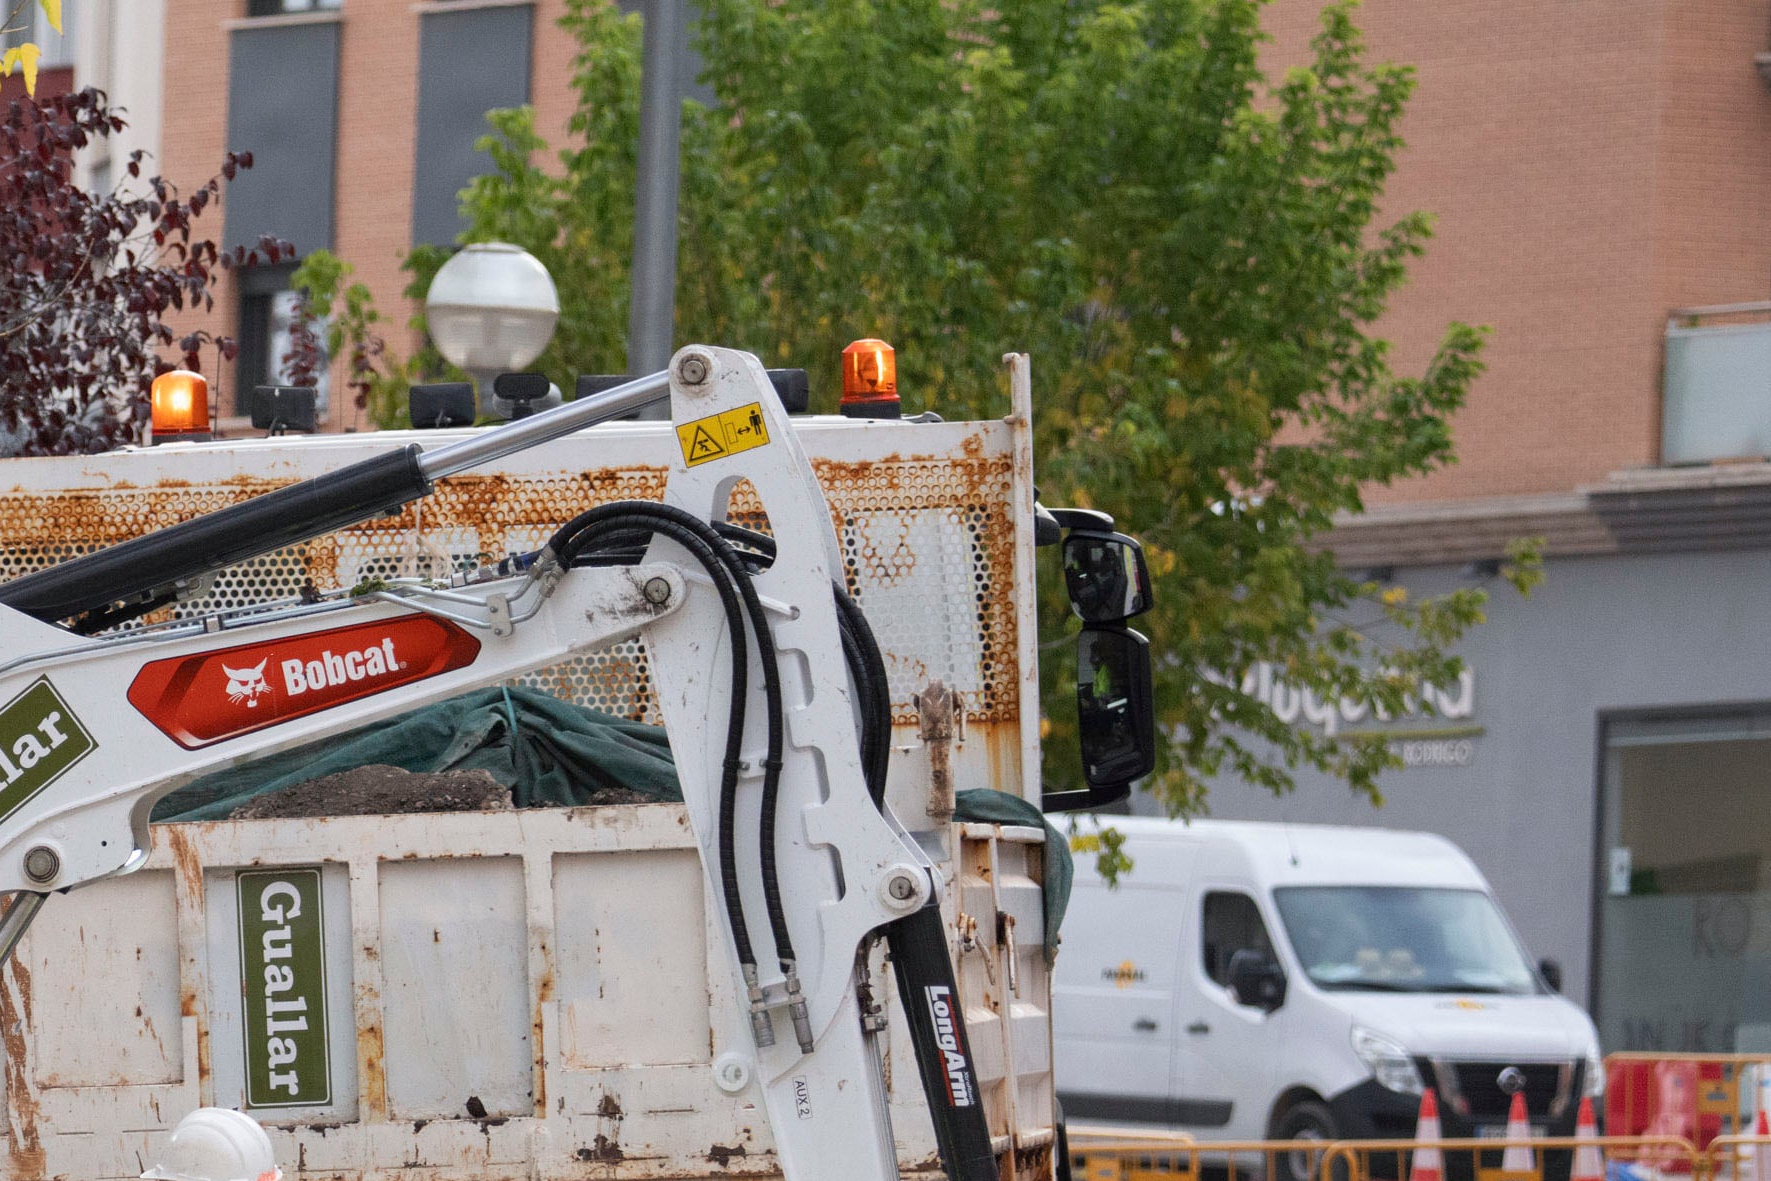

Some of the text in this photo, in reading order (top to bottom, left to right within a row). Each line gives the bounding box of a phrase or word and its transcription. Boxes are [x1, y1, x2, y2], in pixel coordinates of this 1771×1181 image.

[281, 637, 399, 697] Bobcat
[260, 881, 309, 1096] Guallar
[924, 985, 970, 1107] LongArm
[795, 1080, 810, 1116] AUX 2
